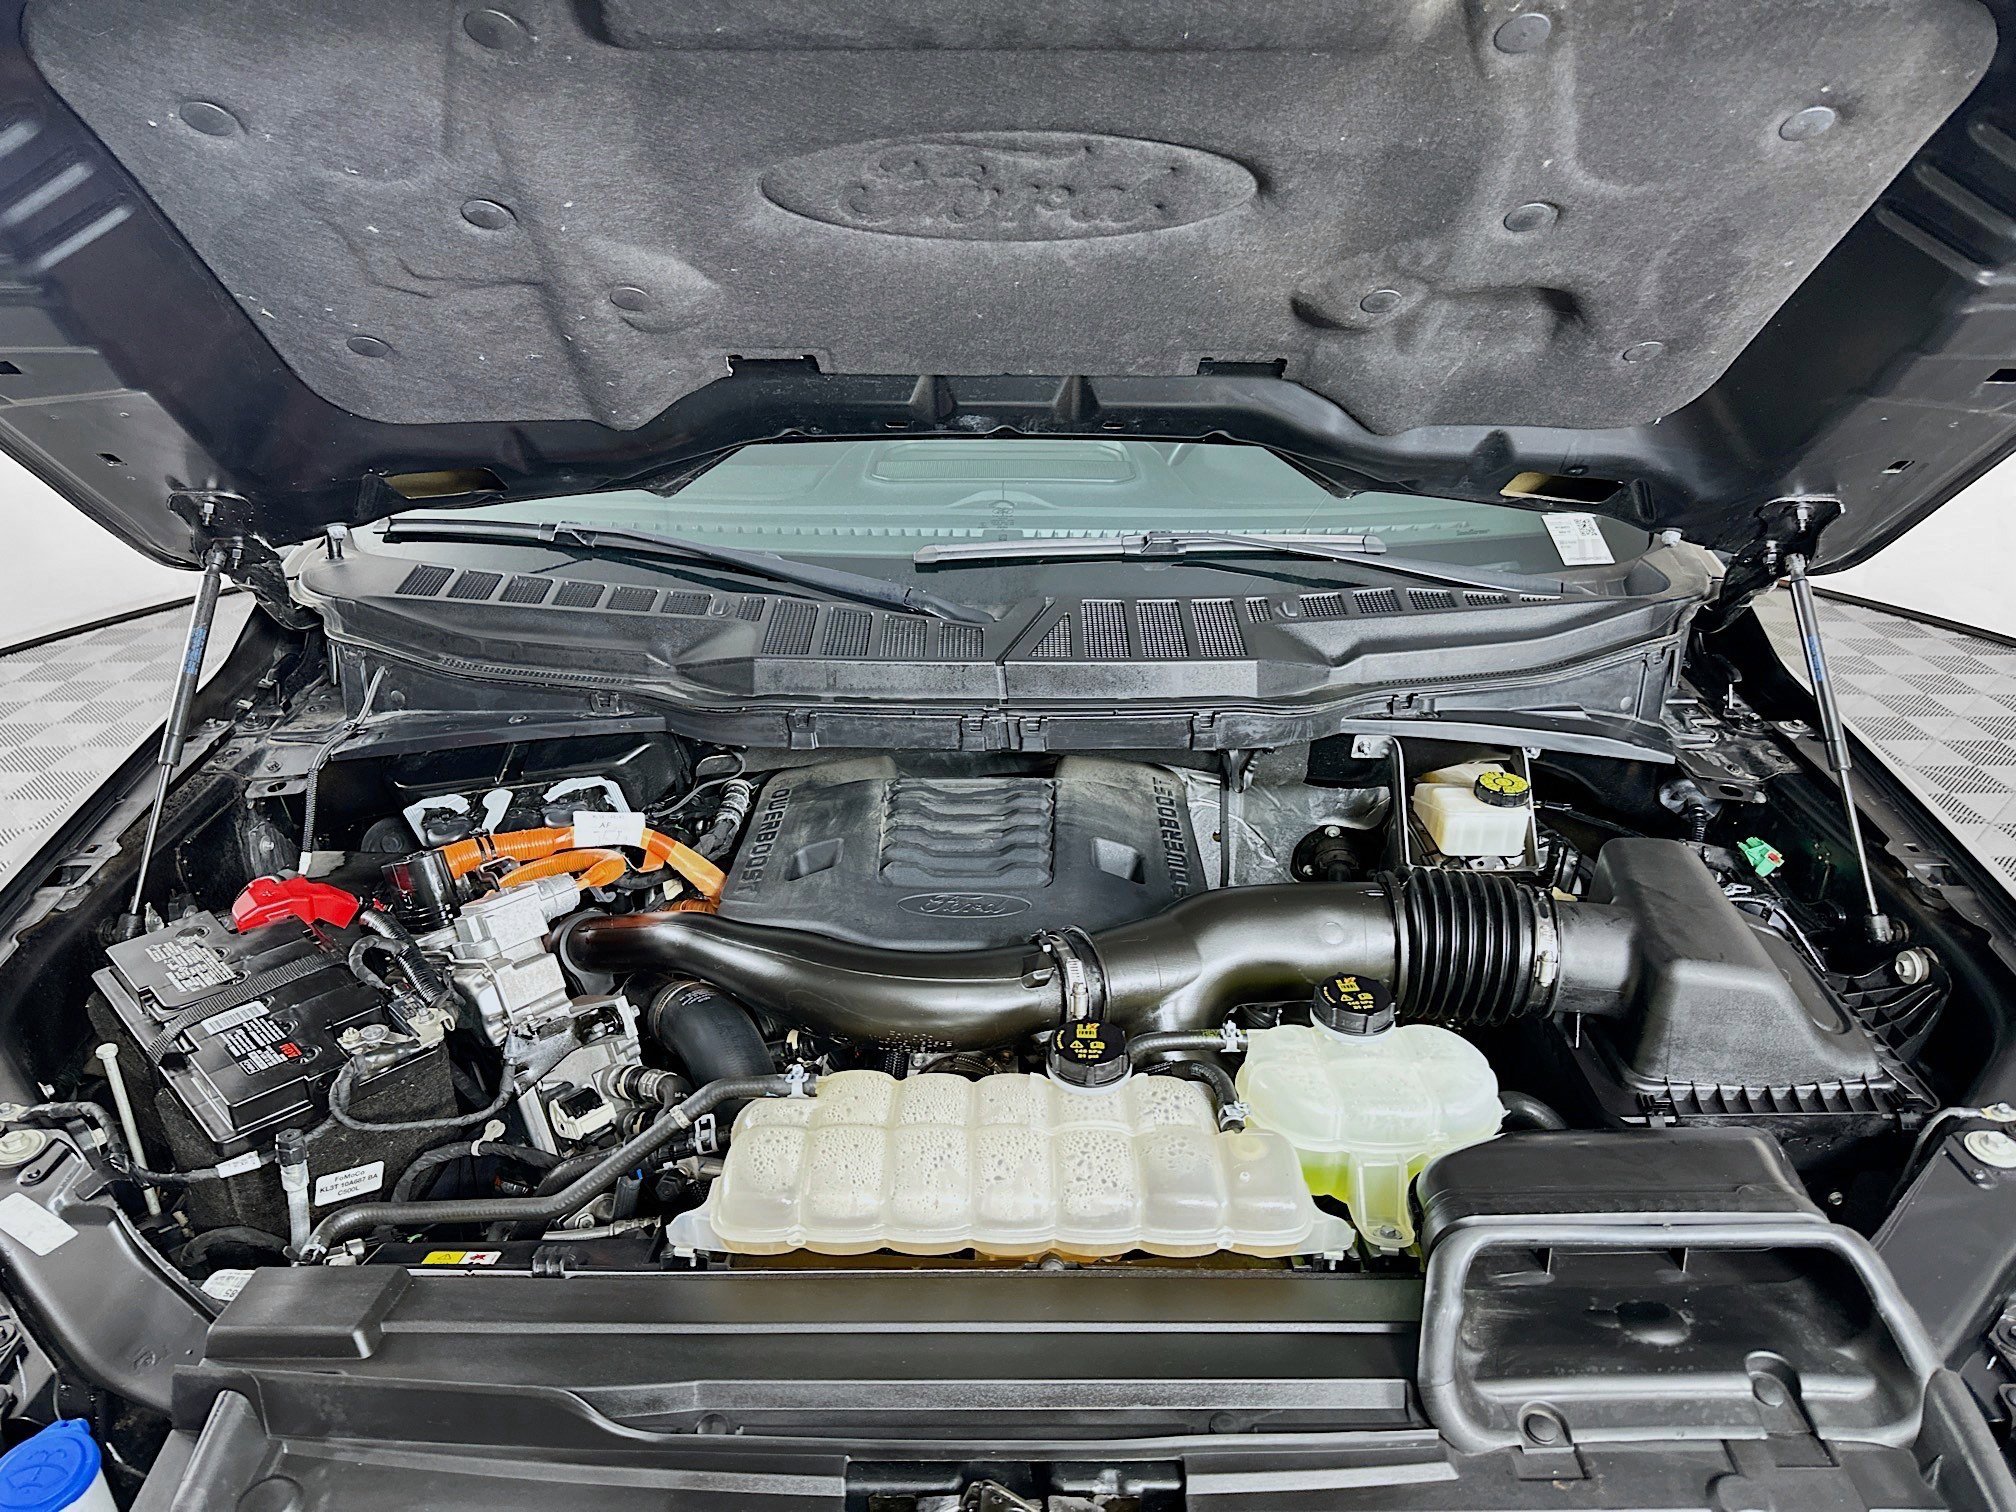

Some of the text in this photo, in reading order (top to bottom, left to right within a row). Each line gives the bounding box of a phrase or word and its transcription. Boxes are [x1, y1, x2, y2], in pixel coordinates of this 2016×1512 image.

[919, 893, 1010, 913] Ford
[334, 1170, 365, 1182] FoMoCo
[319, 1183, 339, 1194] KL3T
